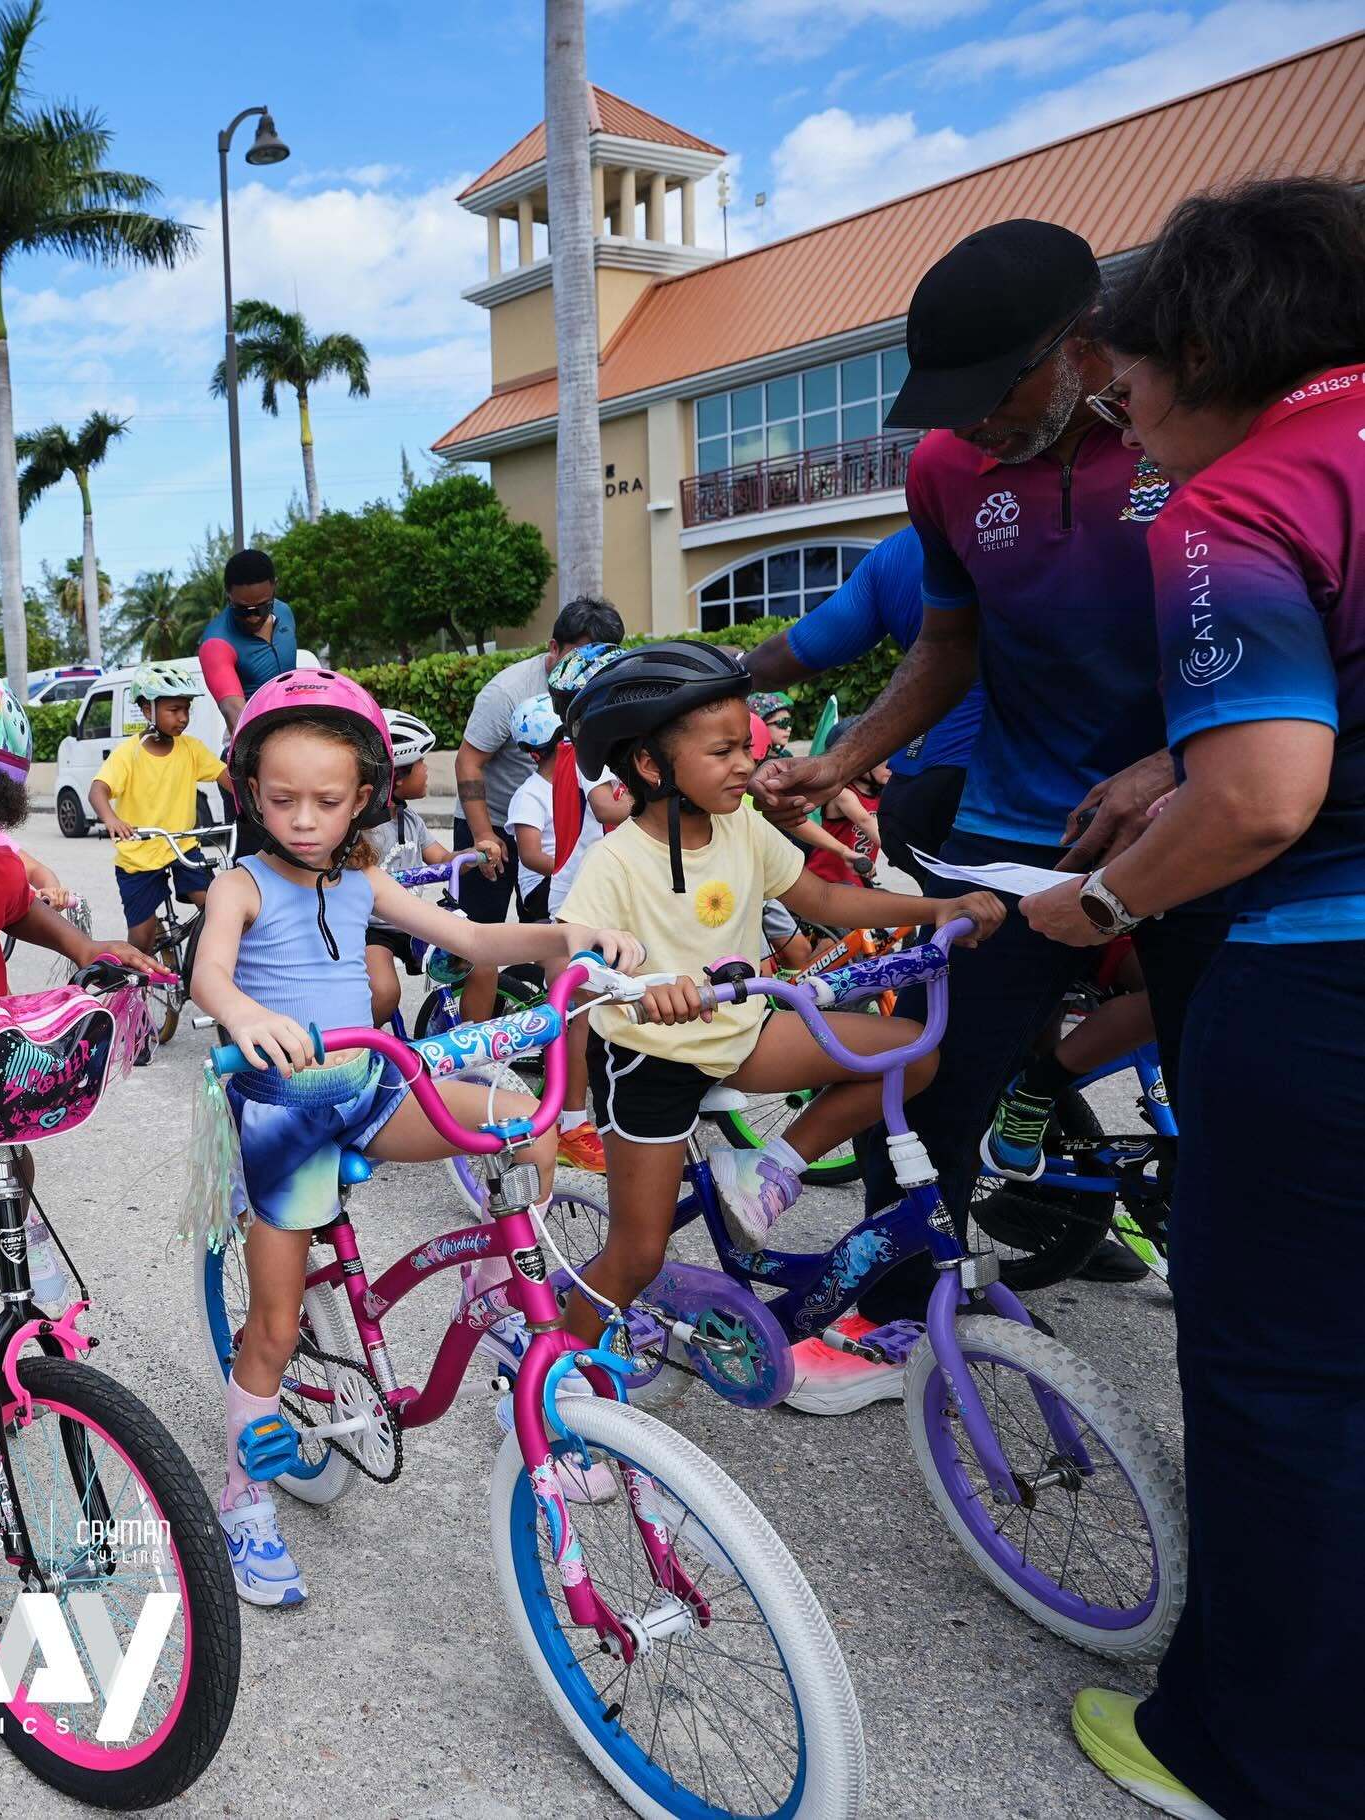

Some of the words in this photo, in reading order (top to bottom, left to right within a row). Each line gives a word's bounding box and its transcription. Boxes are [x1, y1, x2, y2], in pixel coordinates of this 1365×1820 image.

[977, 525, 1019, 545] CAYMAN
[982, 539, 1015, 552] CYCLING
[1184, 530, 1226, 673] CATALYST
[392, 747, 418, 756] COTT
[795, 942, 848, 985] STRIDER
